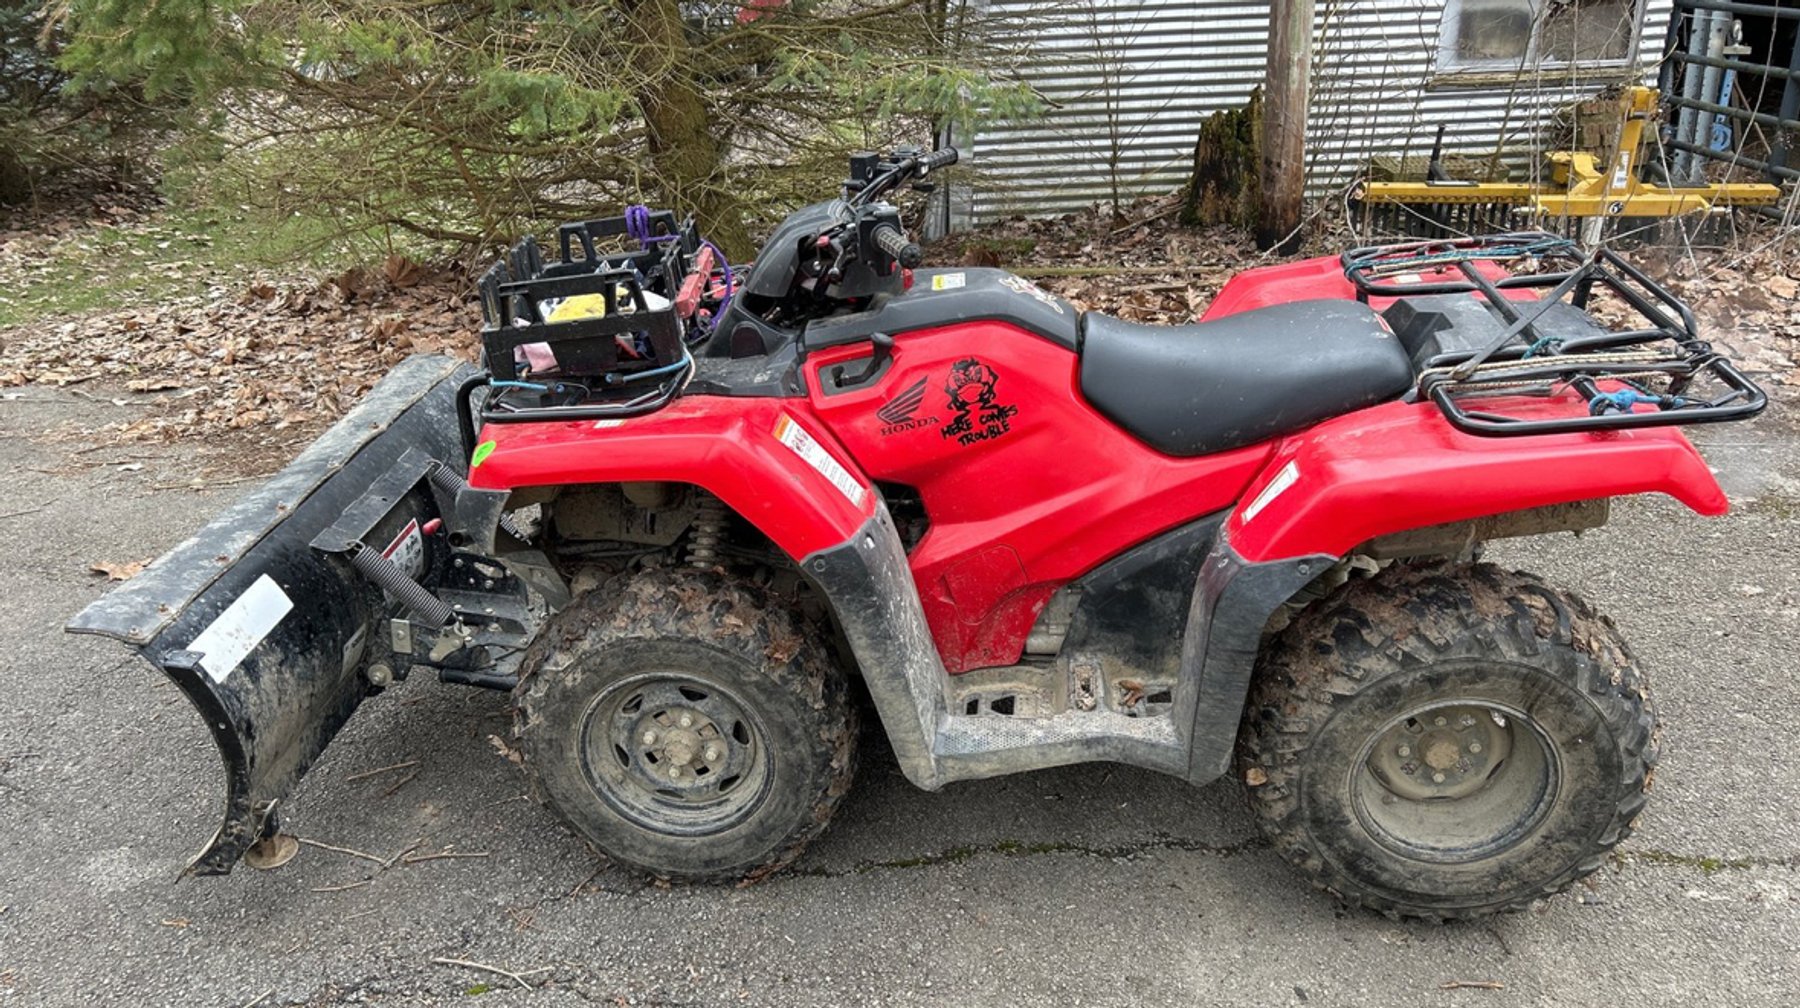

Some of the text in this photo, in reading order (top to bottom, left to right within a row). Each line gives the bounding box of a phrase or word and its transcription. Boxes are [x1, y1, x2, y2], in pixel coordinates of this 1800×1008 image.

[881, 416, 939, 436] HONDA
[941, 404, 1018, 440] HERE COMES
[957, 421, 1010, 447] TROUBLE
